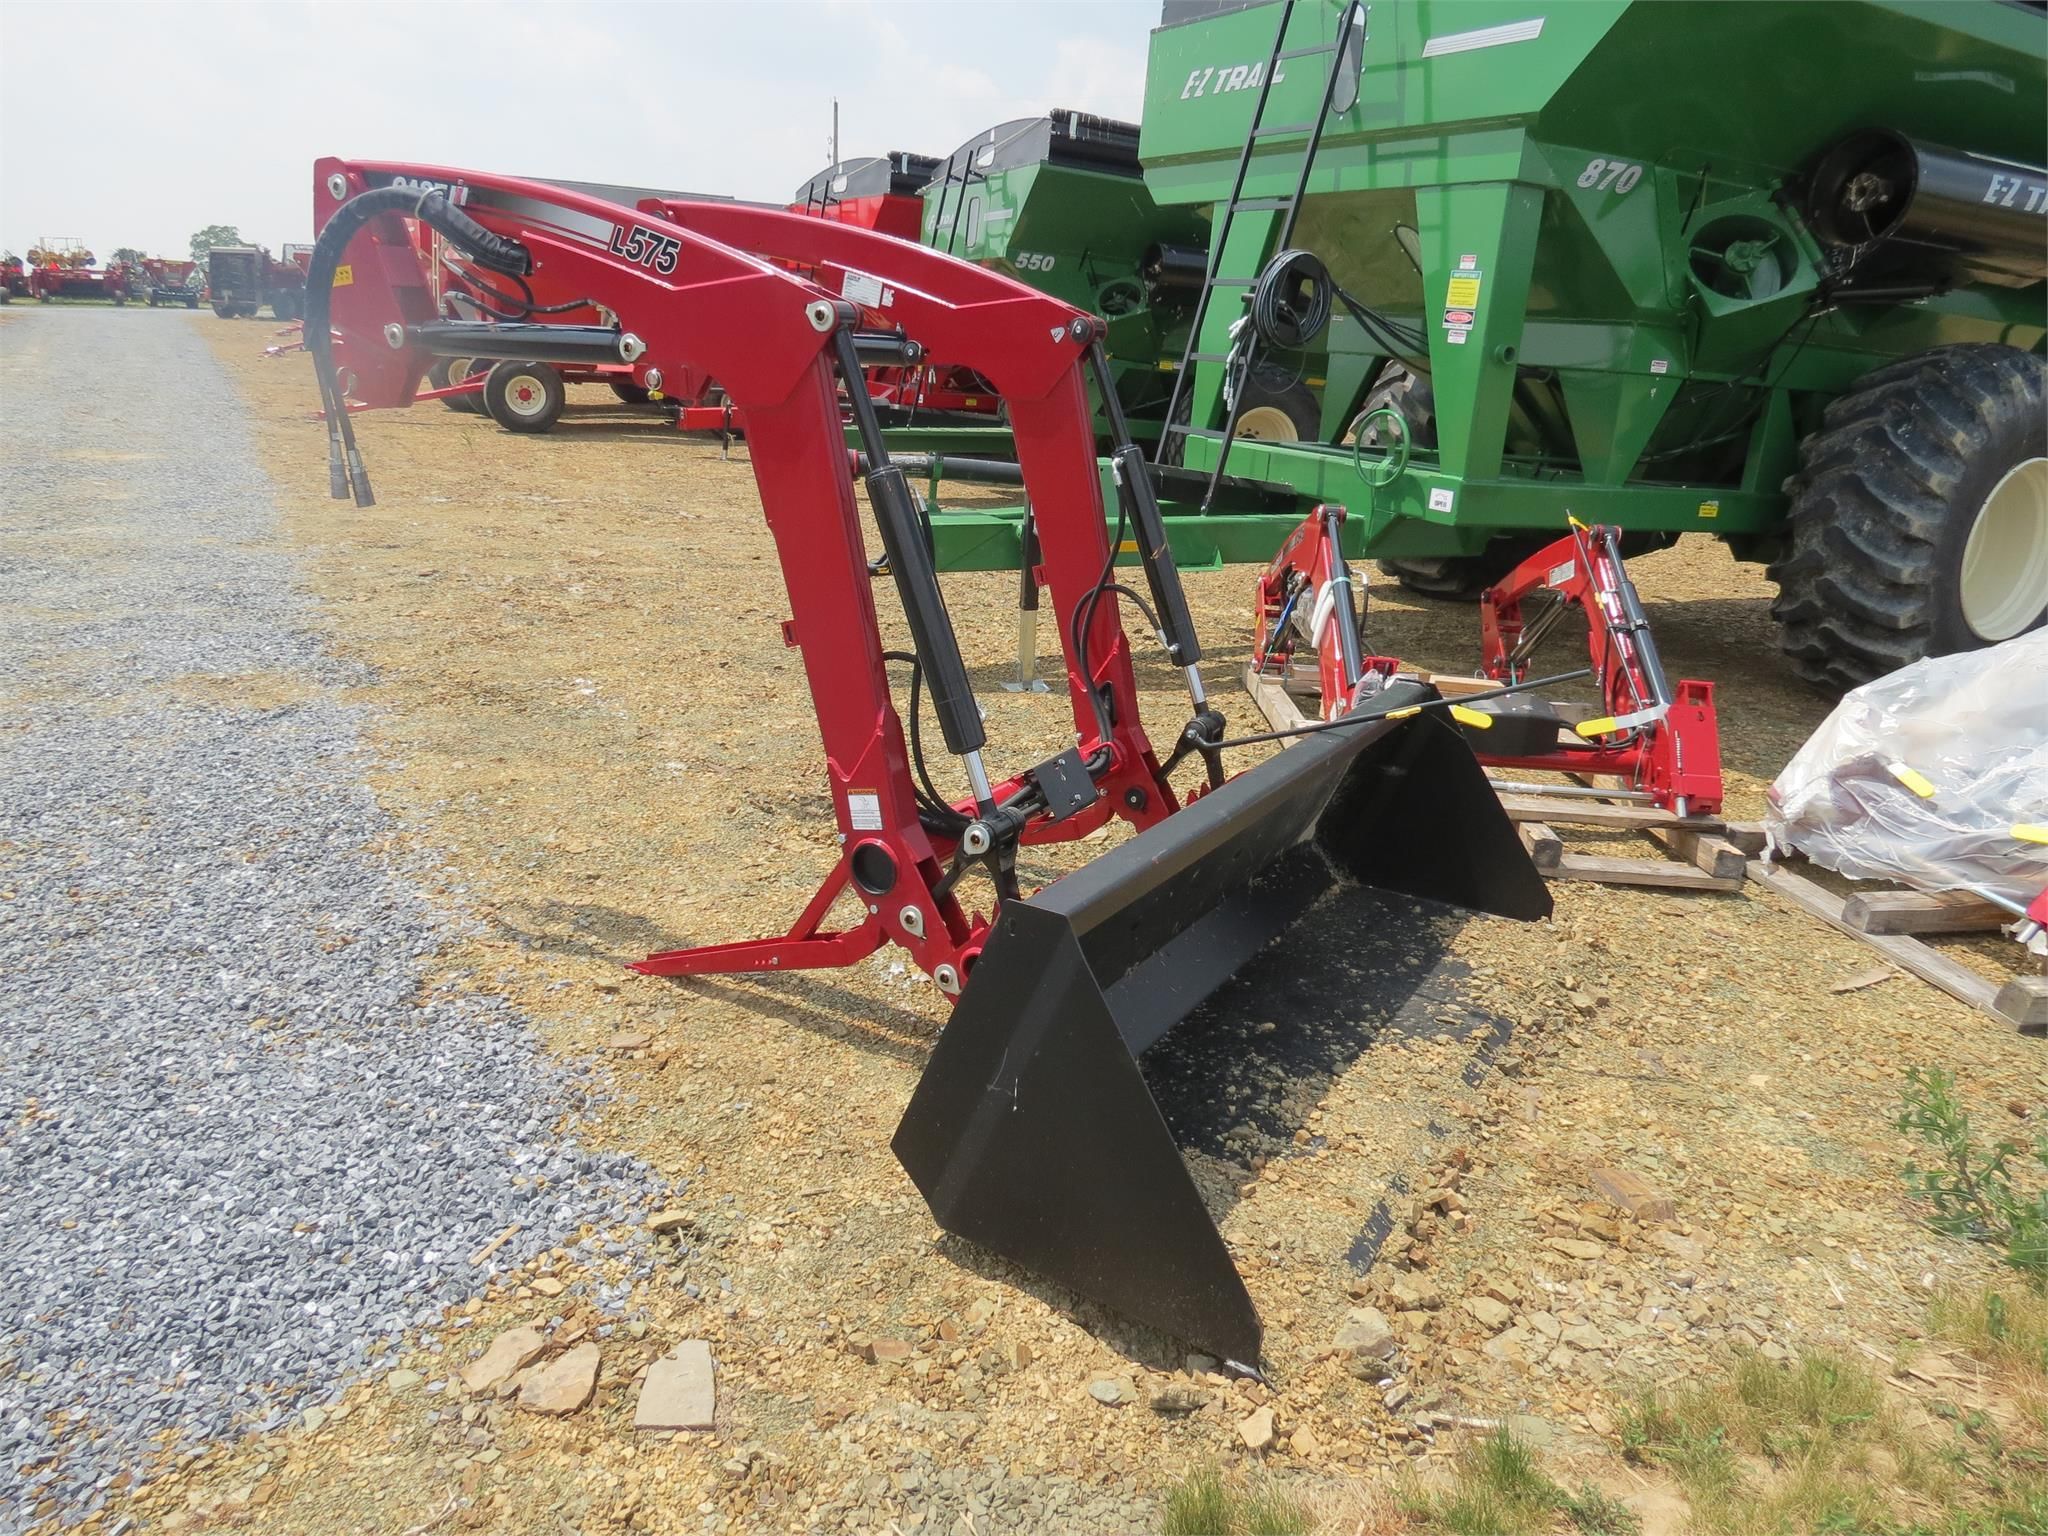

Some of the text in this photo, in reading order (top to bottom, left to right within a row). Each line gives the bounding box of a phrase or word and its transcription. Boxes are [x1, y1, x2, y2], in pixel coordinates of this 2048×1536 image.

[1180, 66, 1215, 100] E-Z
[1577, 158, 1642, 195] 870
[1983, 174, 2023, 207] E-Z
[609, 224, 682, 275] L575
[1014, 251, 1056, 272] 550
